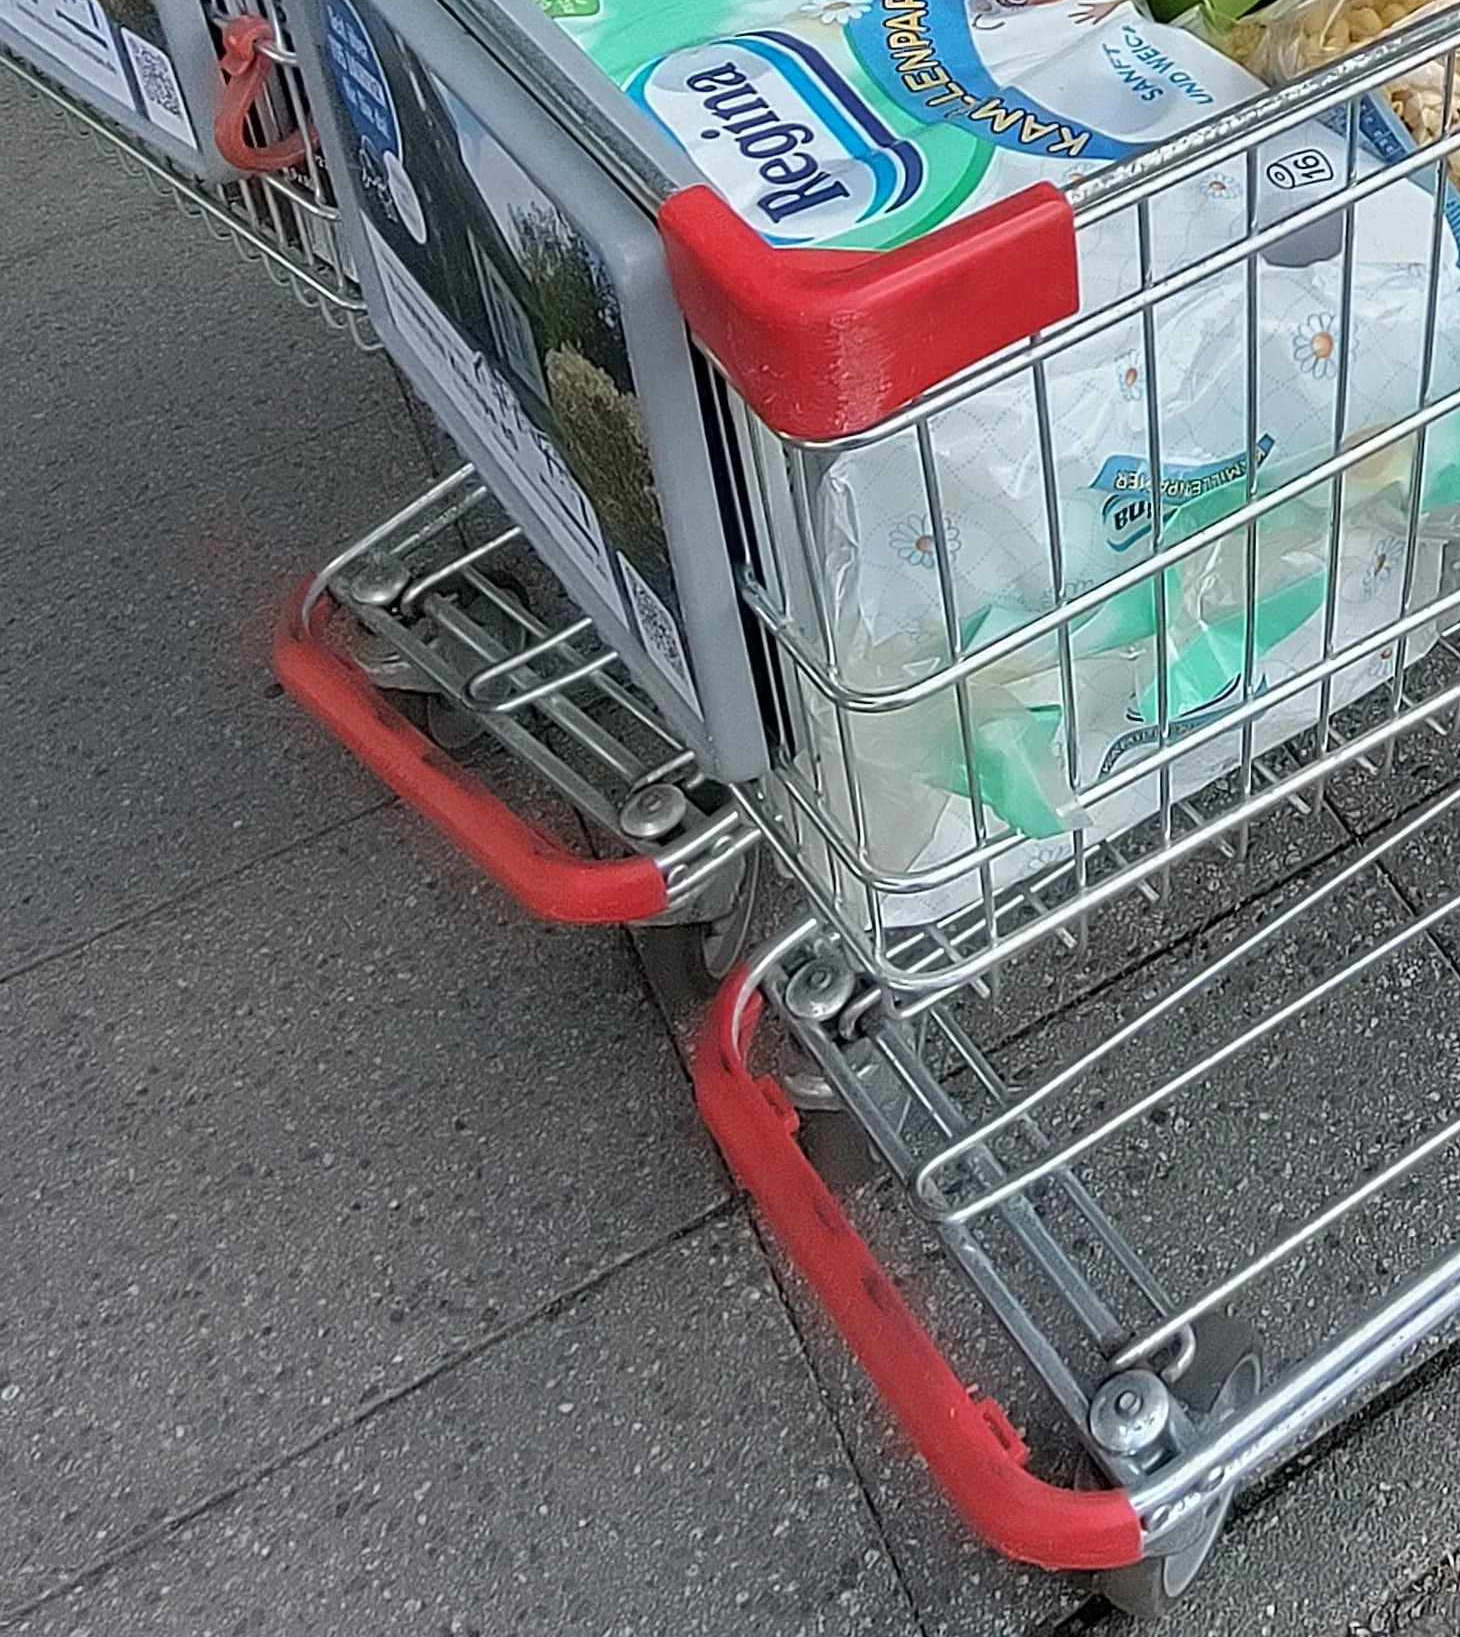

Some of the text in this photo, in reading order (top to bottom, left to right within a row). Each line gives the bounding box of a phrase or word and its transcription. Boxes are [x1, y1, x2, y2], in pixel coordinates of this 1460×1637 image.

[1100, 42, 1166, 103] SANFT
[1170, 67, 1215, 105] UND
[686, 62, 850, 225] Regina
[1295, 154, 1326, 181] 16
[1112, 500, 1152, 532] ina
